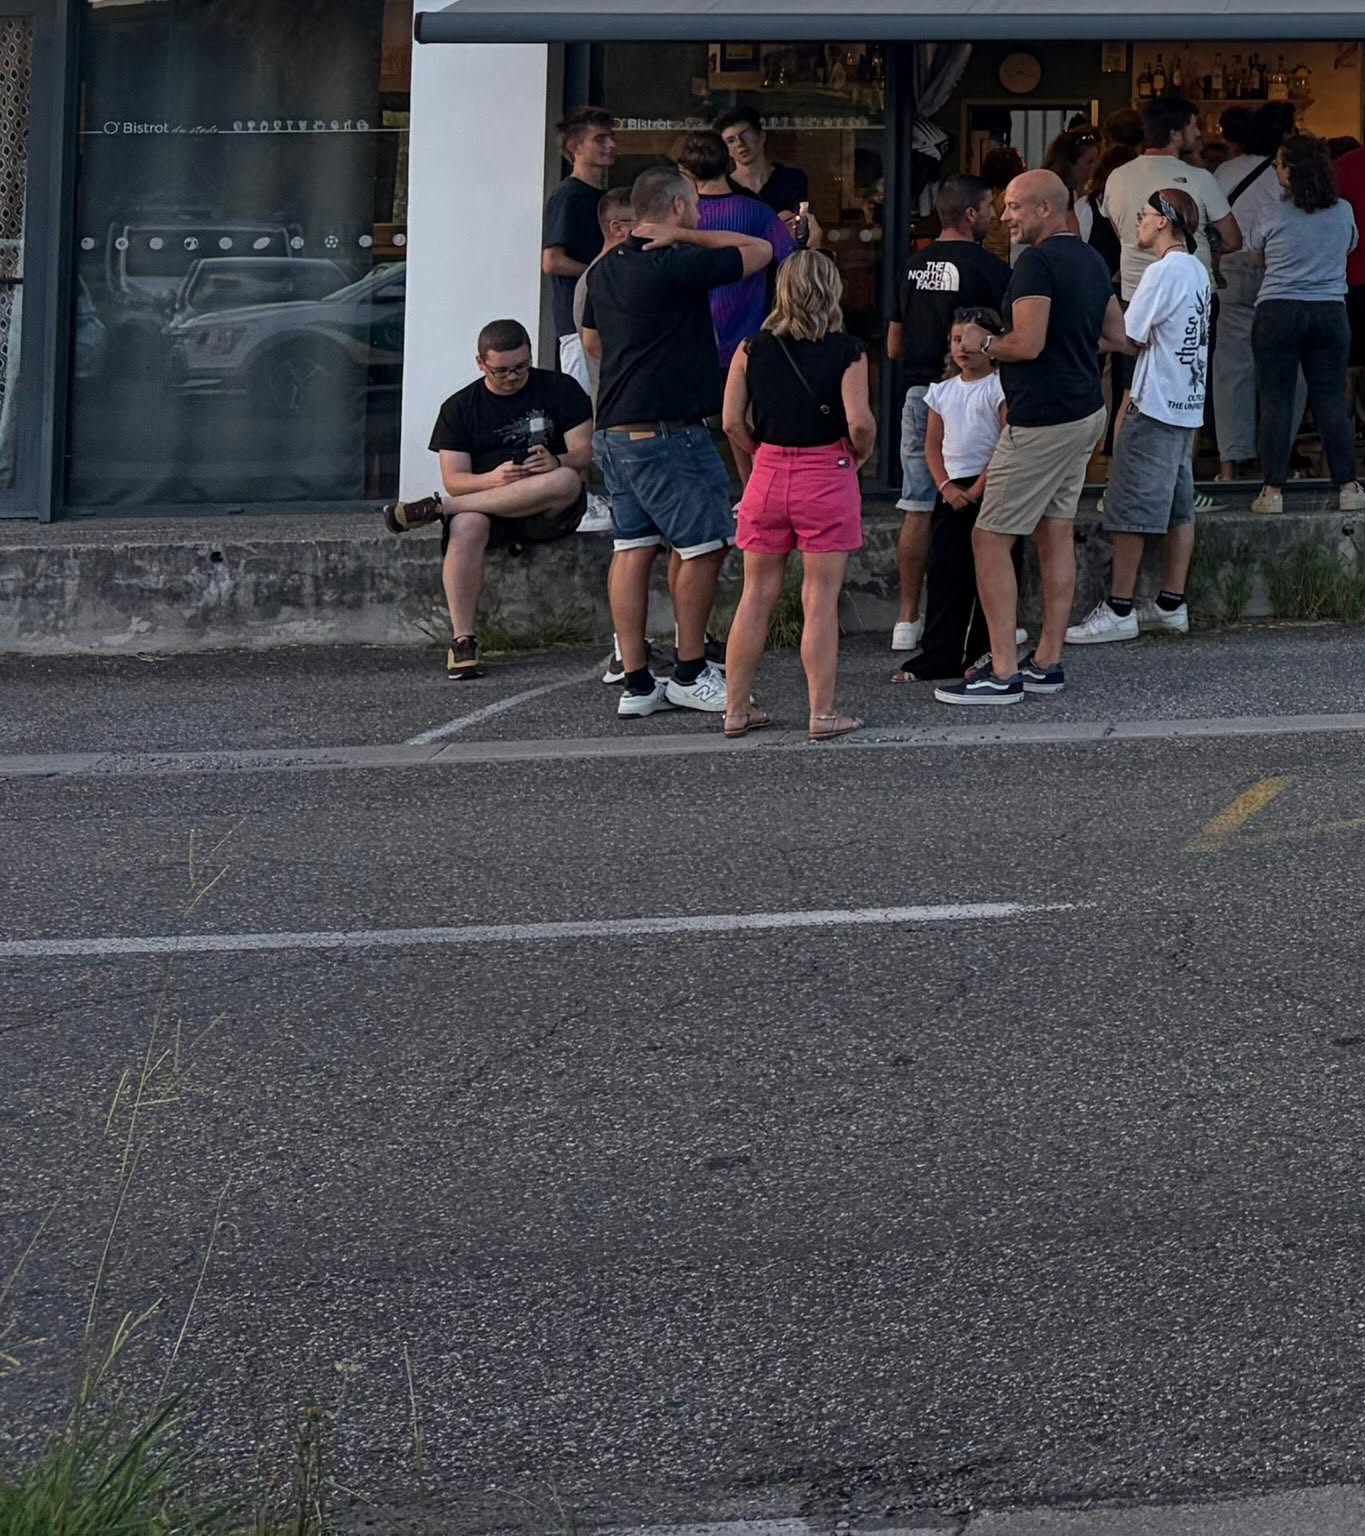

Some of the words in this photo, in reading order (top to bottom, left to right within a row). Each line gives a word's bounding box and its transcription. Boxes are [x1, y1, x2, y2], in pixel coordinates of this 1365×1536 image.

[123, 122, 168, 134] Bistrot
[627, 117, 672, 130] Bistrot
[926, 261, 945, 272] THE
[907, 270, 943, 281] NORTH
[916, 279, 941, 291] FACE
